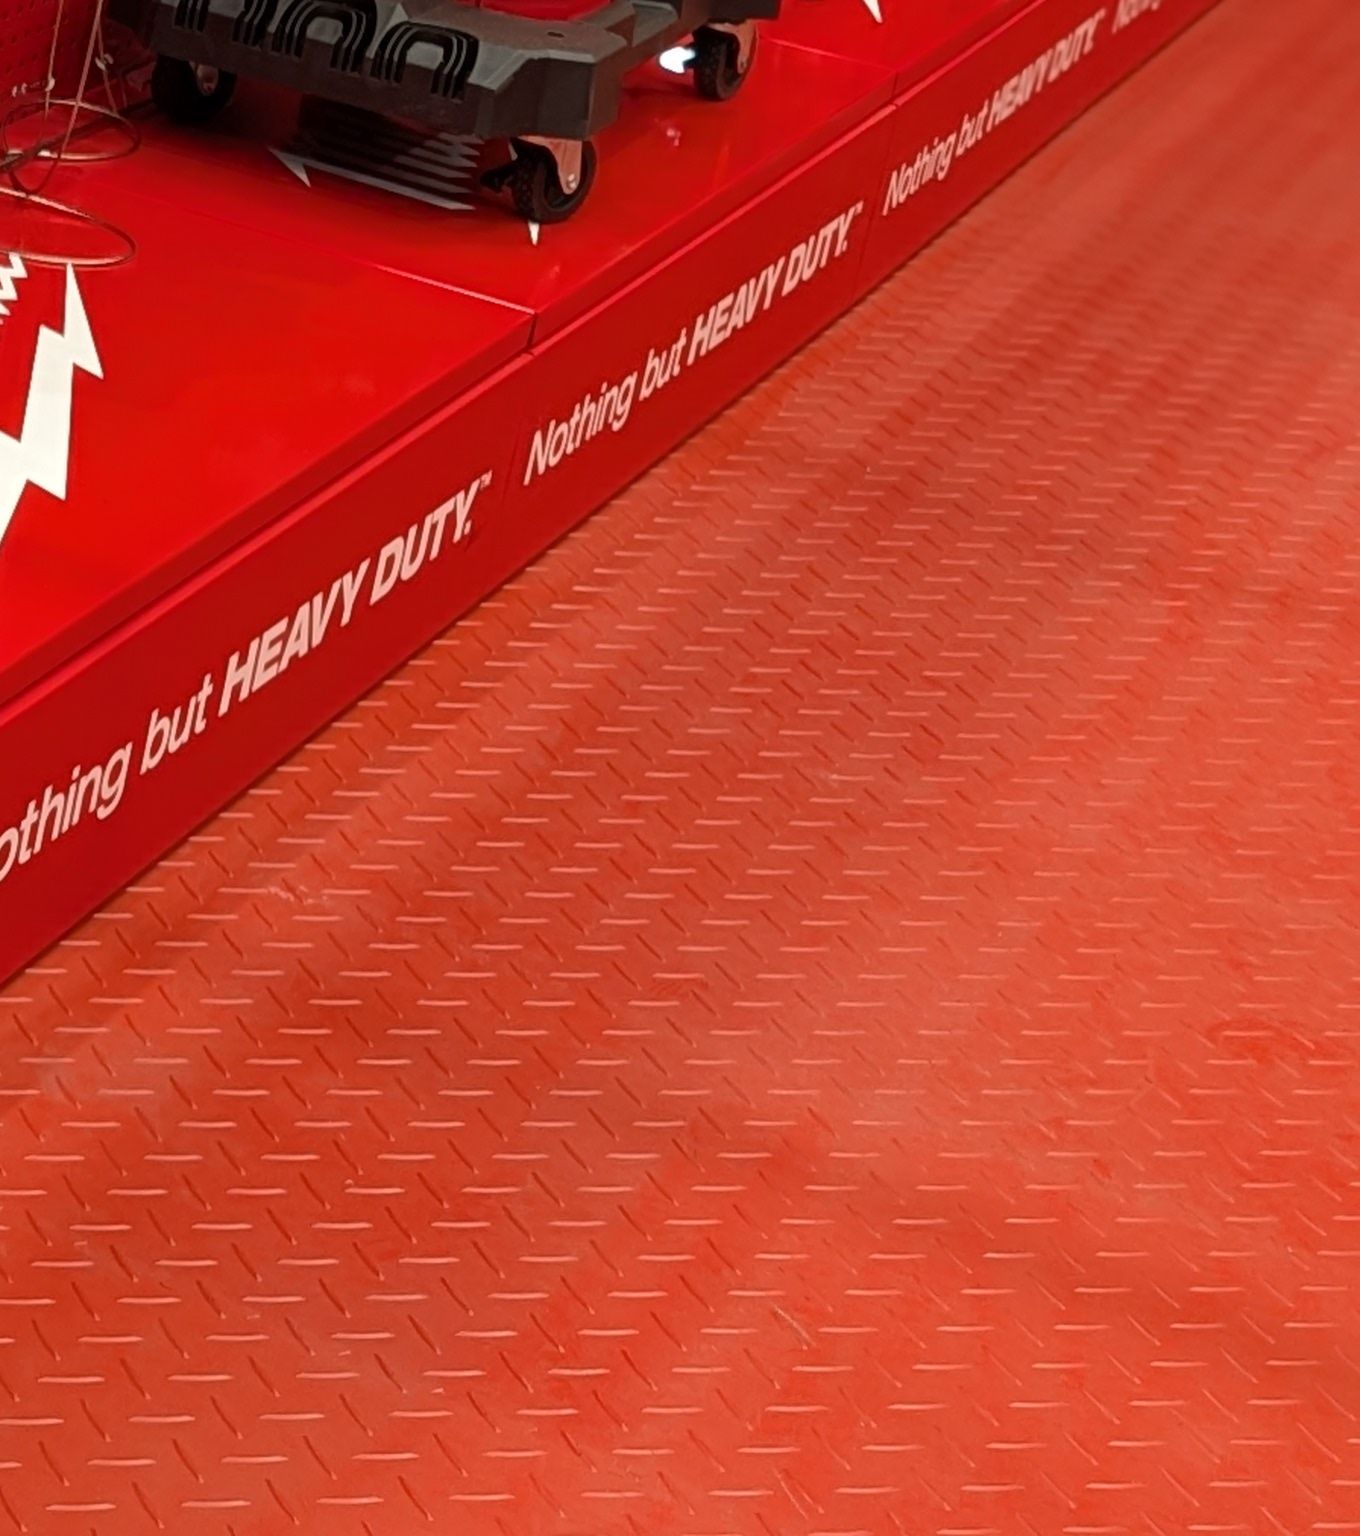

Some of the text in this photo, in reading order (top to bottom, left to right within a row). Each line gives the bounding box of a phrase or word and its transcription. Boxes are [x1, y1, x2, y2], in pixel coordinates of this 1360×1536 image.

[882, 48, 1053, 216] Nothing but HEAVY
[523, 371, 637, 486] Nothing
[639, 327, 686, 401] but
[687, 256, 785, 366] HEAVY
[140, 673, 213, 775] but
[219, 558, 370, 716] HEAVY
